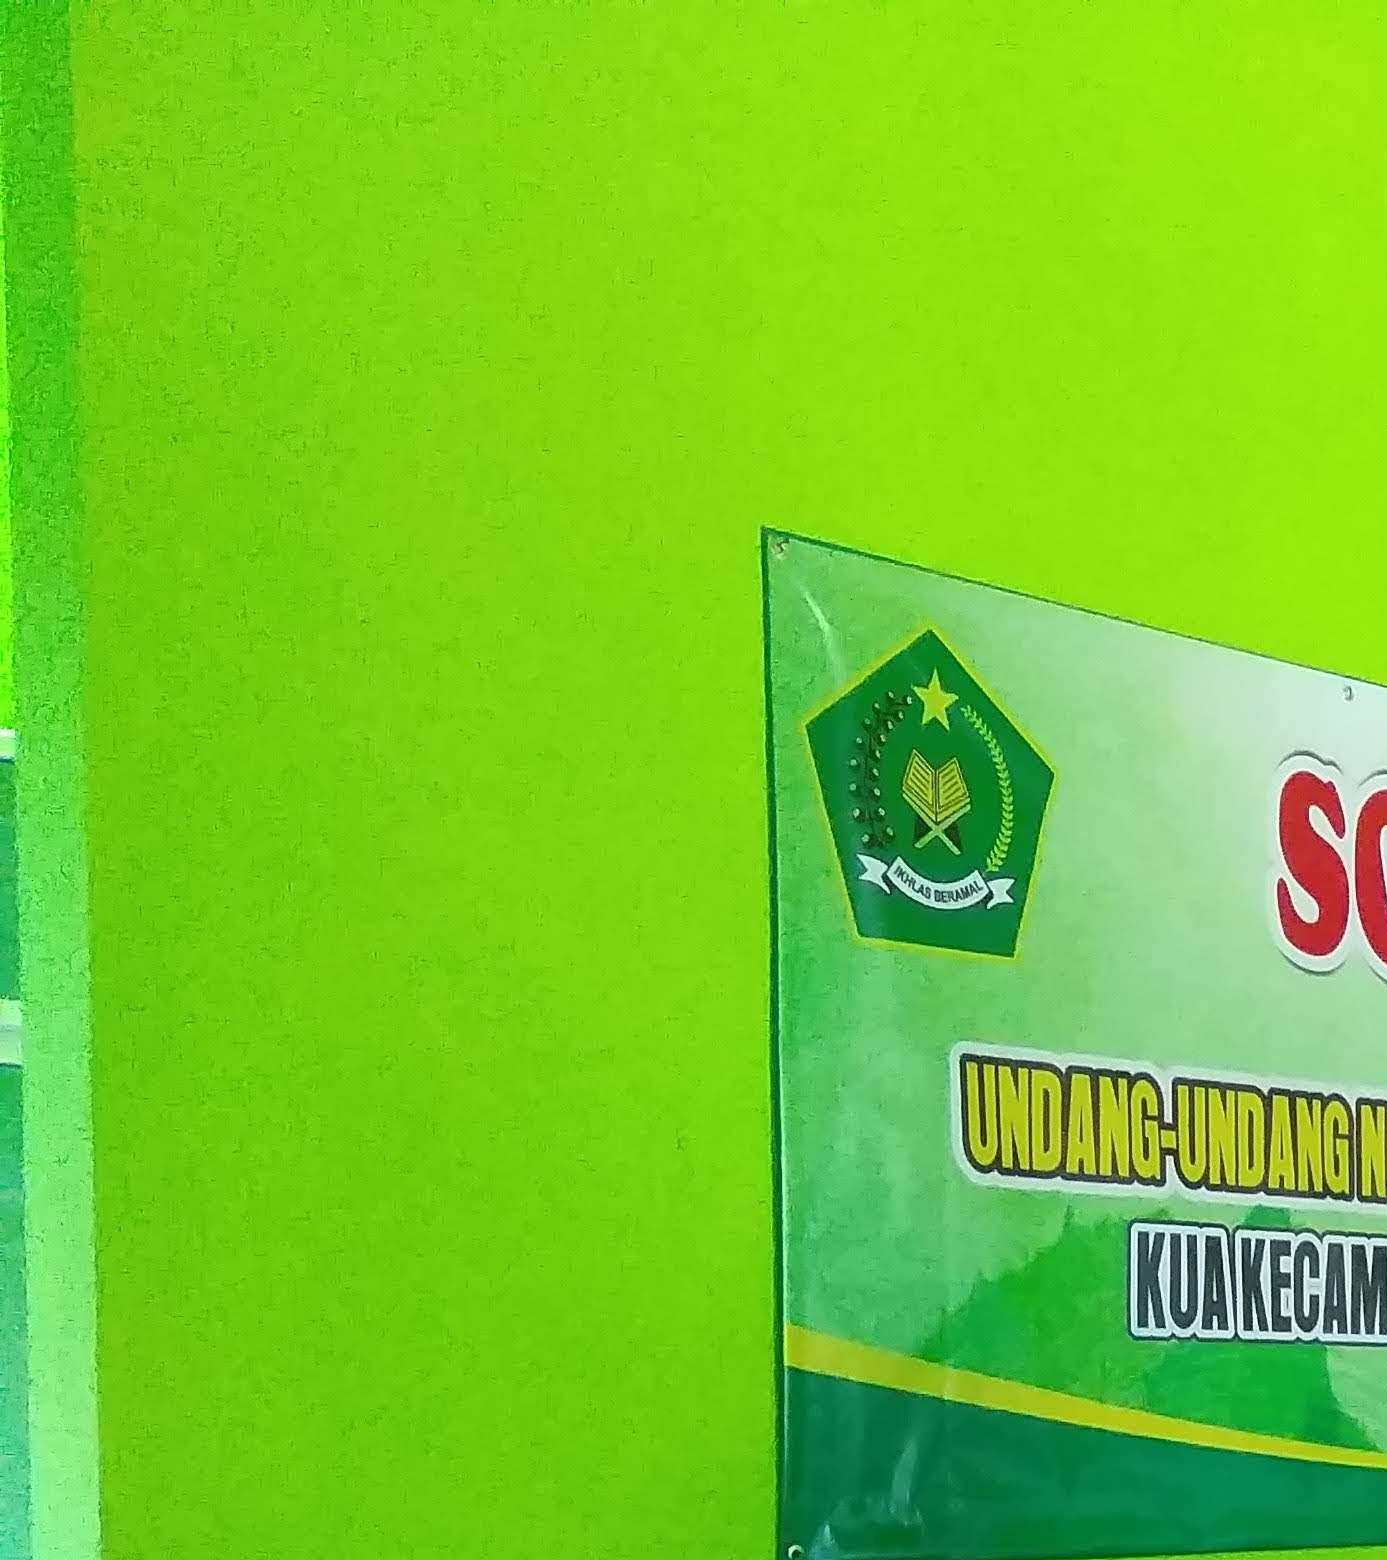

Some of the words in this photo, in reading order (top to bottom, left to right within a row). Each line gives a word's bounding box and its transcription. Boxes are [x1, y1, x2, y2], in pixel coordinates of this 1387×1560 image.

[893, 865, 931, 899] IKHLAS
[933, 880, 983, 903] BERAMAL
[963, 1056, 1351, 1197] UNDANG-UNDANG
[1136, 1230, 1230, 1333] KUA
